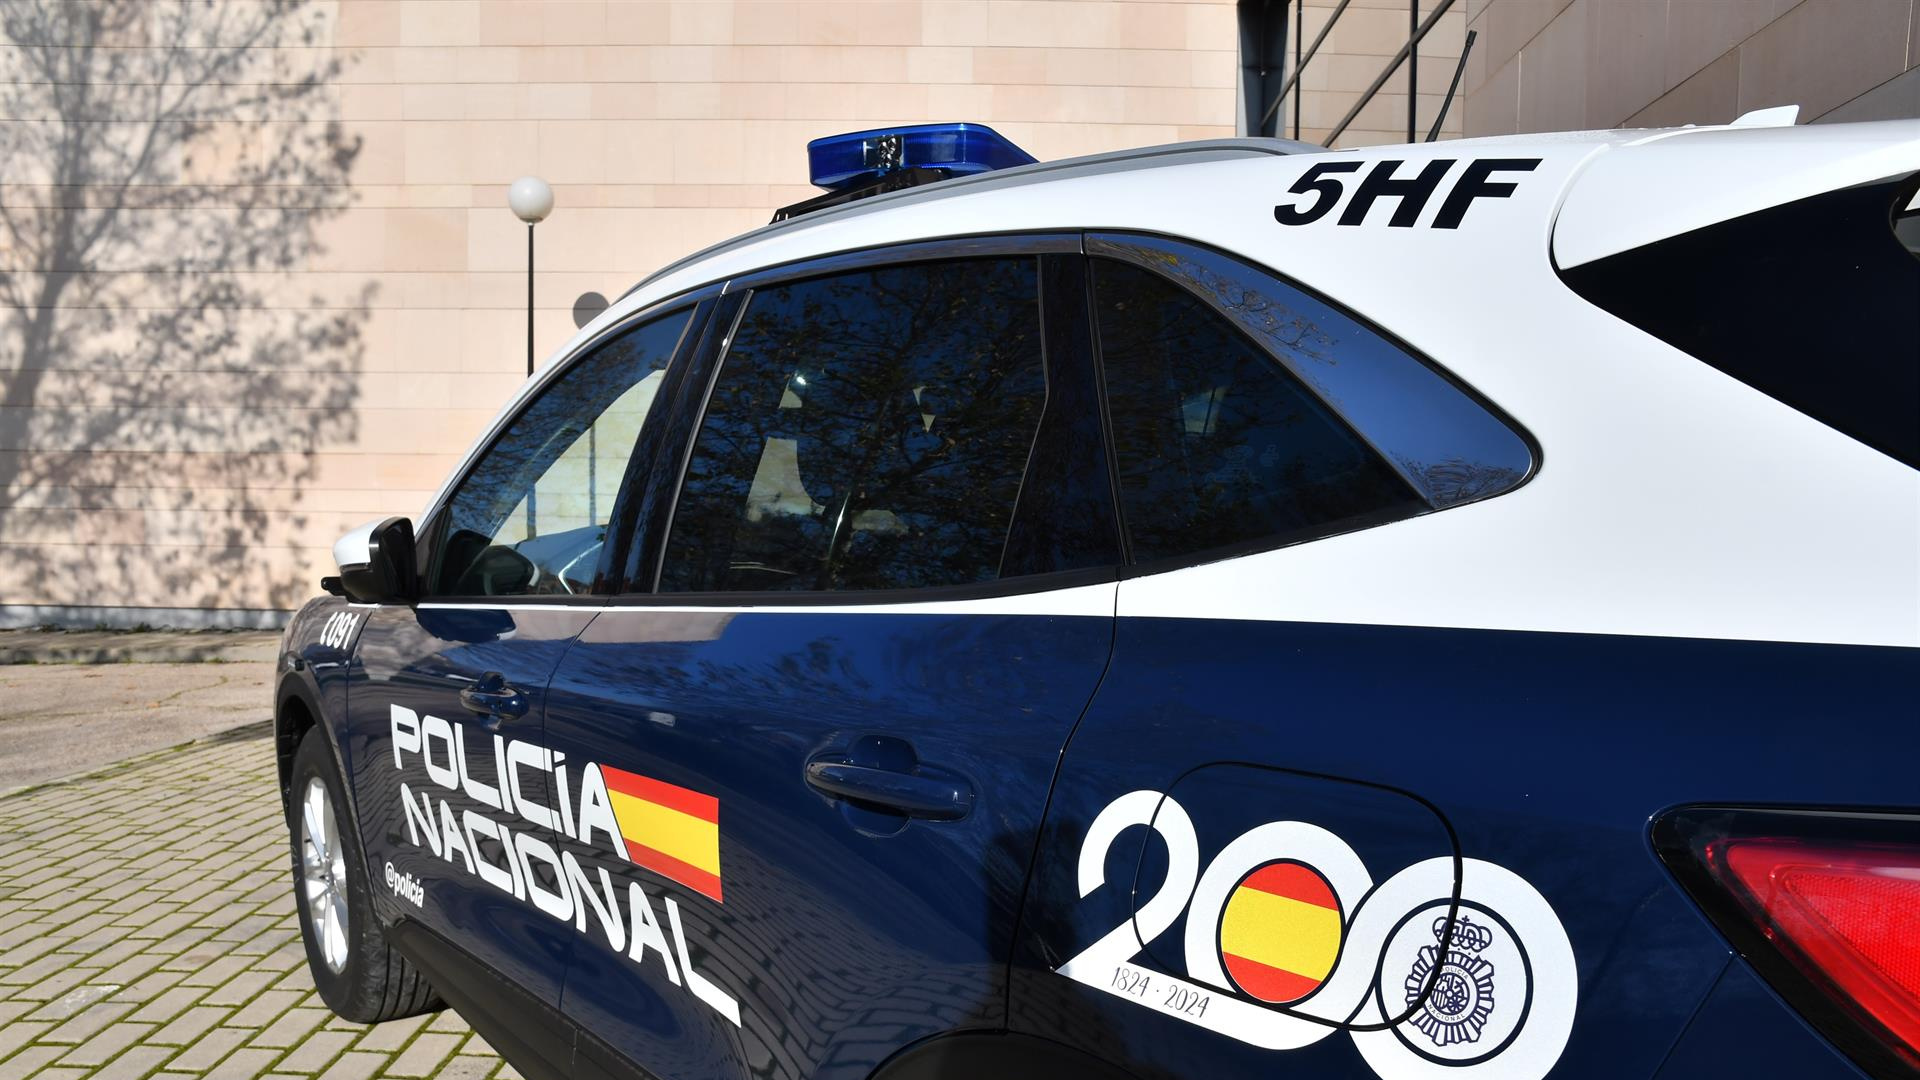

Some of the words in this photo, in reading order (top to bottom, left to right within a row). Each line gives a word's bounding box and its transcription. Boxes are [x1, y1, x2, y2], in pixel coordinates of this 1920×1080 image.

[1274, 158, 1543, 229] 5HF
[326, 611, 360, 650] 091
[400, 783, 742, 1029] NACIONAL
[1111, 967, 1151, 997] 1824
[1164, 984, 1210, 1018] 2024
[1427, 1004, 1466, 1021] NACIONAL
